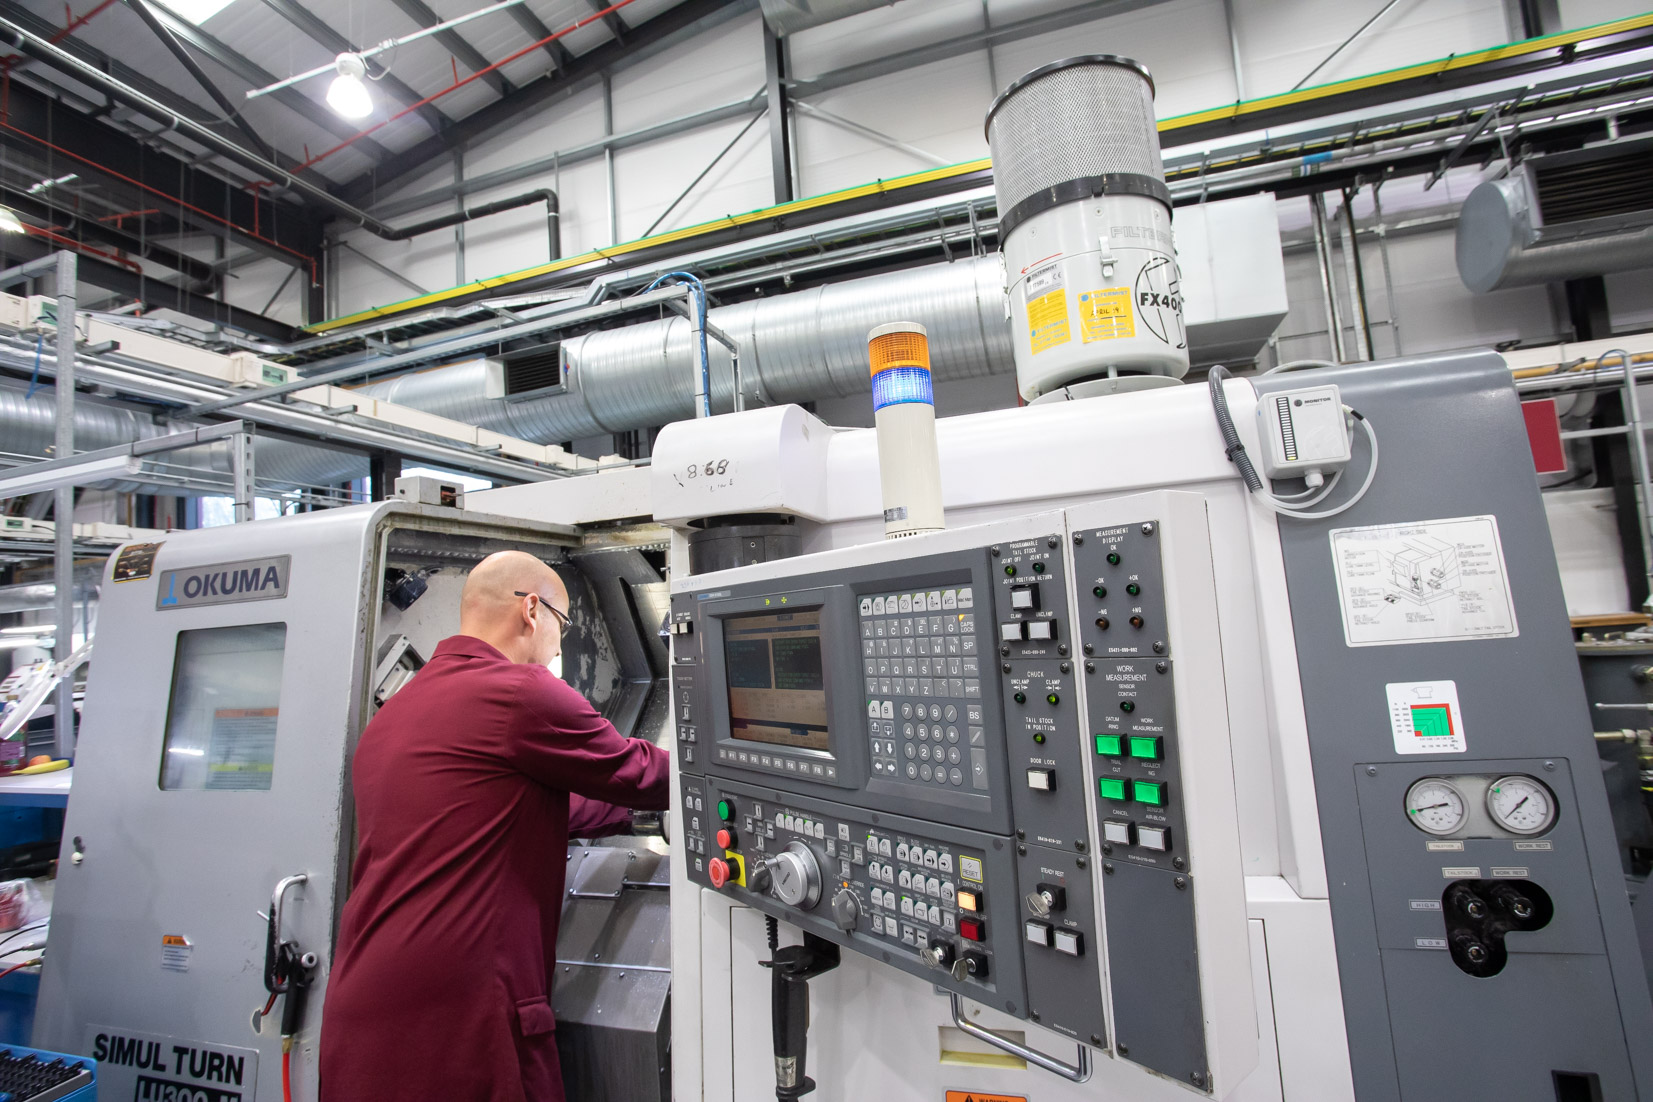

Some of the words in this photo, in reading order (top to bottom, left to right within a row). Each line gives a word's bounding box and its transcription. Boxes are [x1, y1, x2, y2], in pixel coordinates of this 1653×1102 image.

[1096, 527, 1129, 537] MEASUREMENT
[1010, 540, 1038, 549] PROGRAMMABLE
[183, 565, 280, 598] OKUMA
[934, 730, 939, 738] 6
[963, 868, 978, 877] RESET
[1041, 867, 1054, 875] STEADY
[962, 881, 977, 889] CONTROL
[93, 1033, 167, 1072] SIMUL
[173, 1046, 244, 1086] TURN
